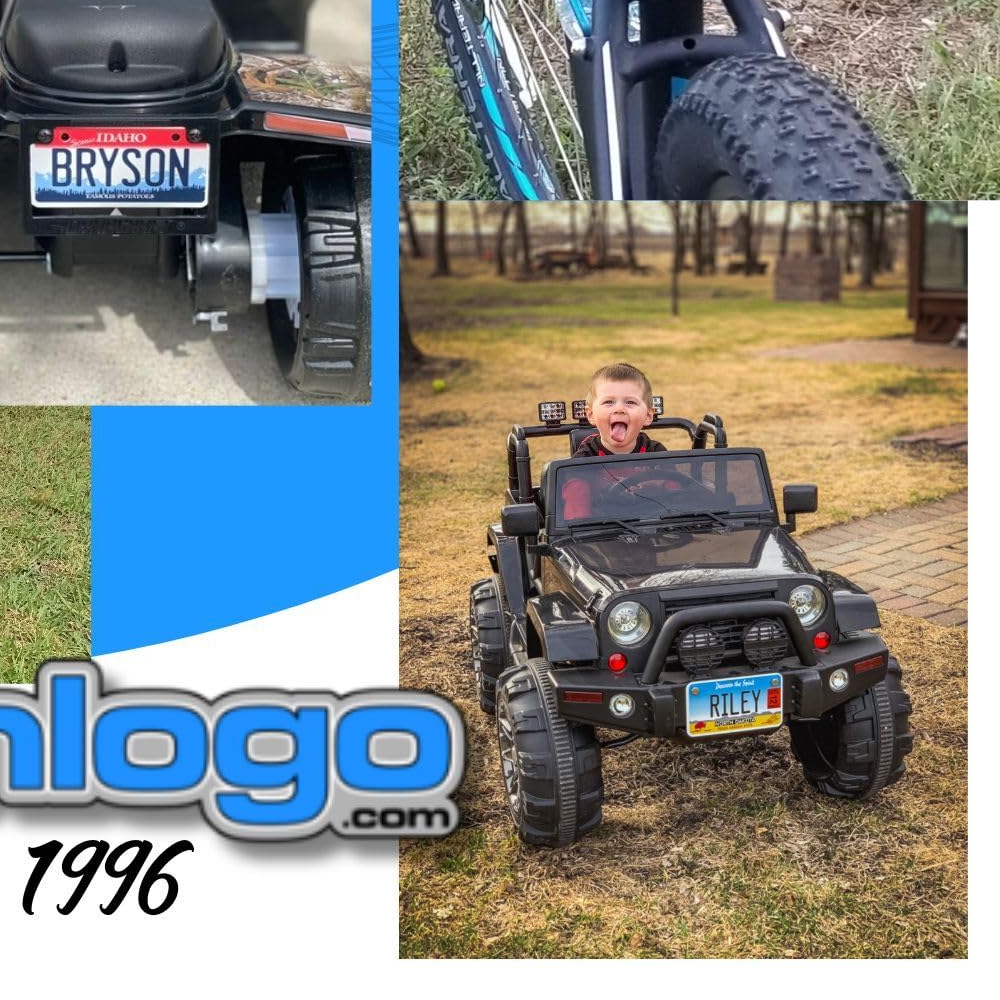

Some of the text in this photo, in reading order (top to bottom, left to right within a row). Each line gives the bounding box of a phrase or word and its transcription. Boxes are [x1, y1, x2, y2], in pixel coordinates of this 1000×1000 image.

[96, 132, 147, 143] IDAHO
[51, 147, 190, 187] BRYSON
[709, 689, 761, 717] RILEY
